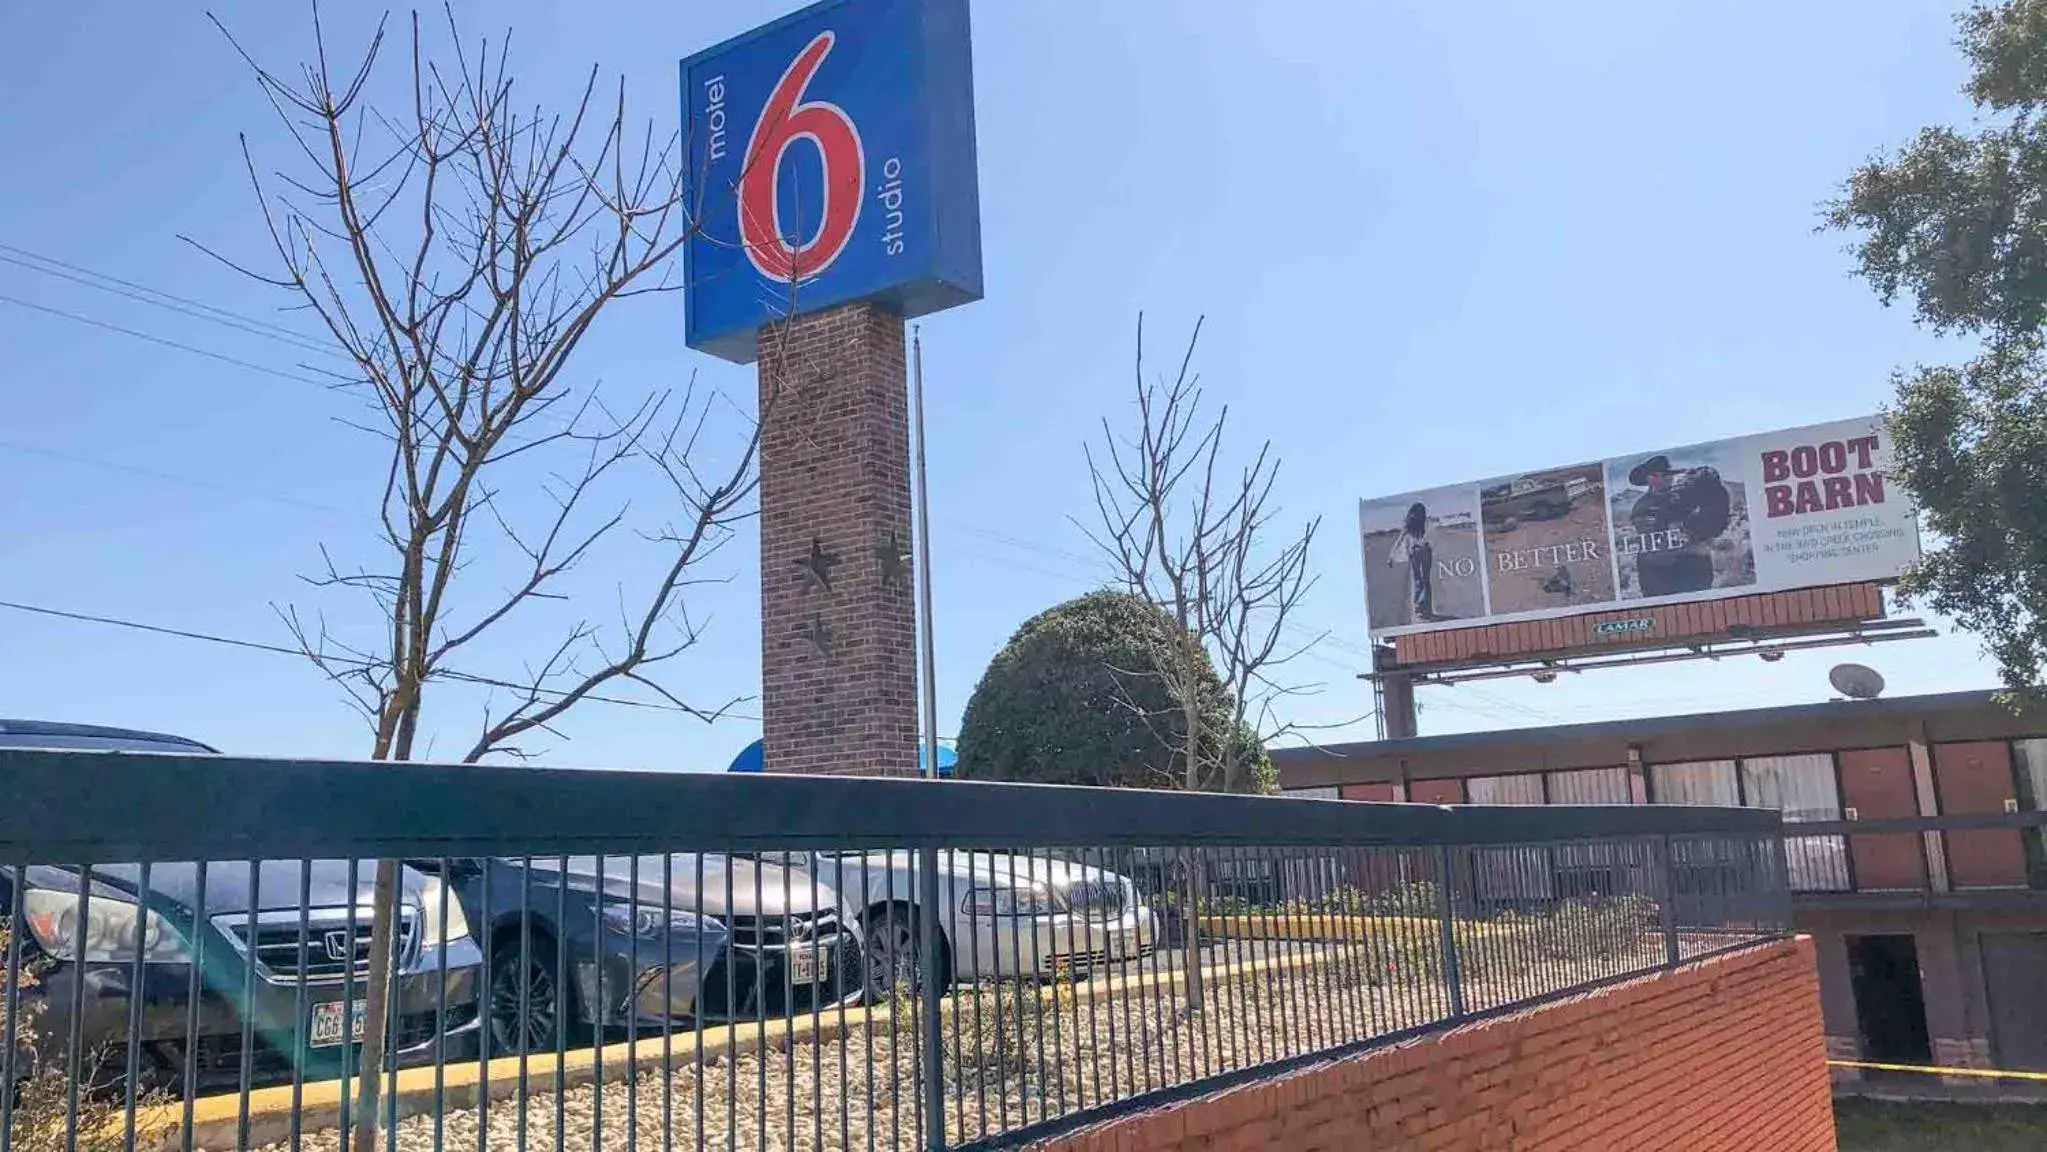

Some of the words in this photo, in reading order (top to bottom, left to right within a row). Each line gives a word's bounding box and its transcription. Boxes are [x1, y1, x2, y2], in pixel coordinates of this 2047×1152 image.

[704, 75, 727, 161] motel
[737, 29, 865, 283] 6
[877, 157, 903, 256] studio
[1761, 435, 1879, 482] BOOT
[1765, 471, 1885, 518] BARN
[1438, 558, 1475, 579] NO
[1498, 540, 1600, 571] BETTER
[1622, 528, 1682, 554] LIFE
[1598, 617, 1650, 633] LAMAR
